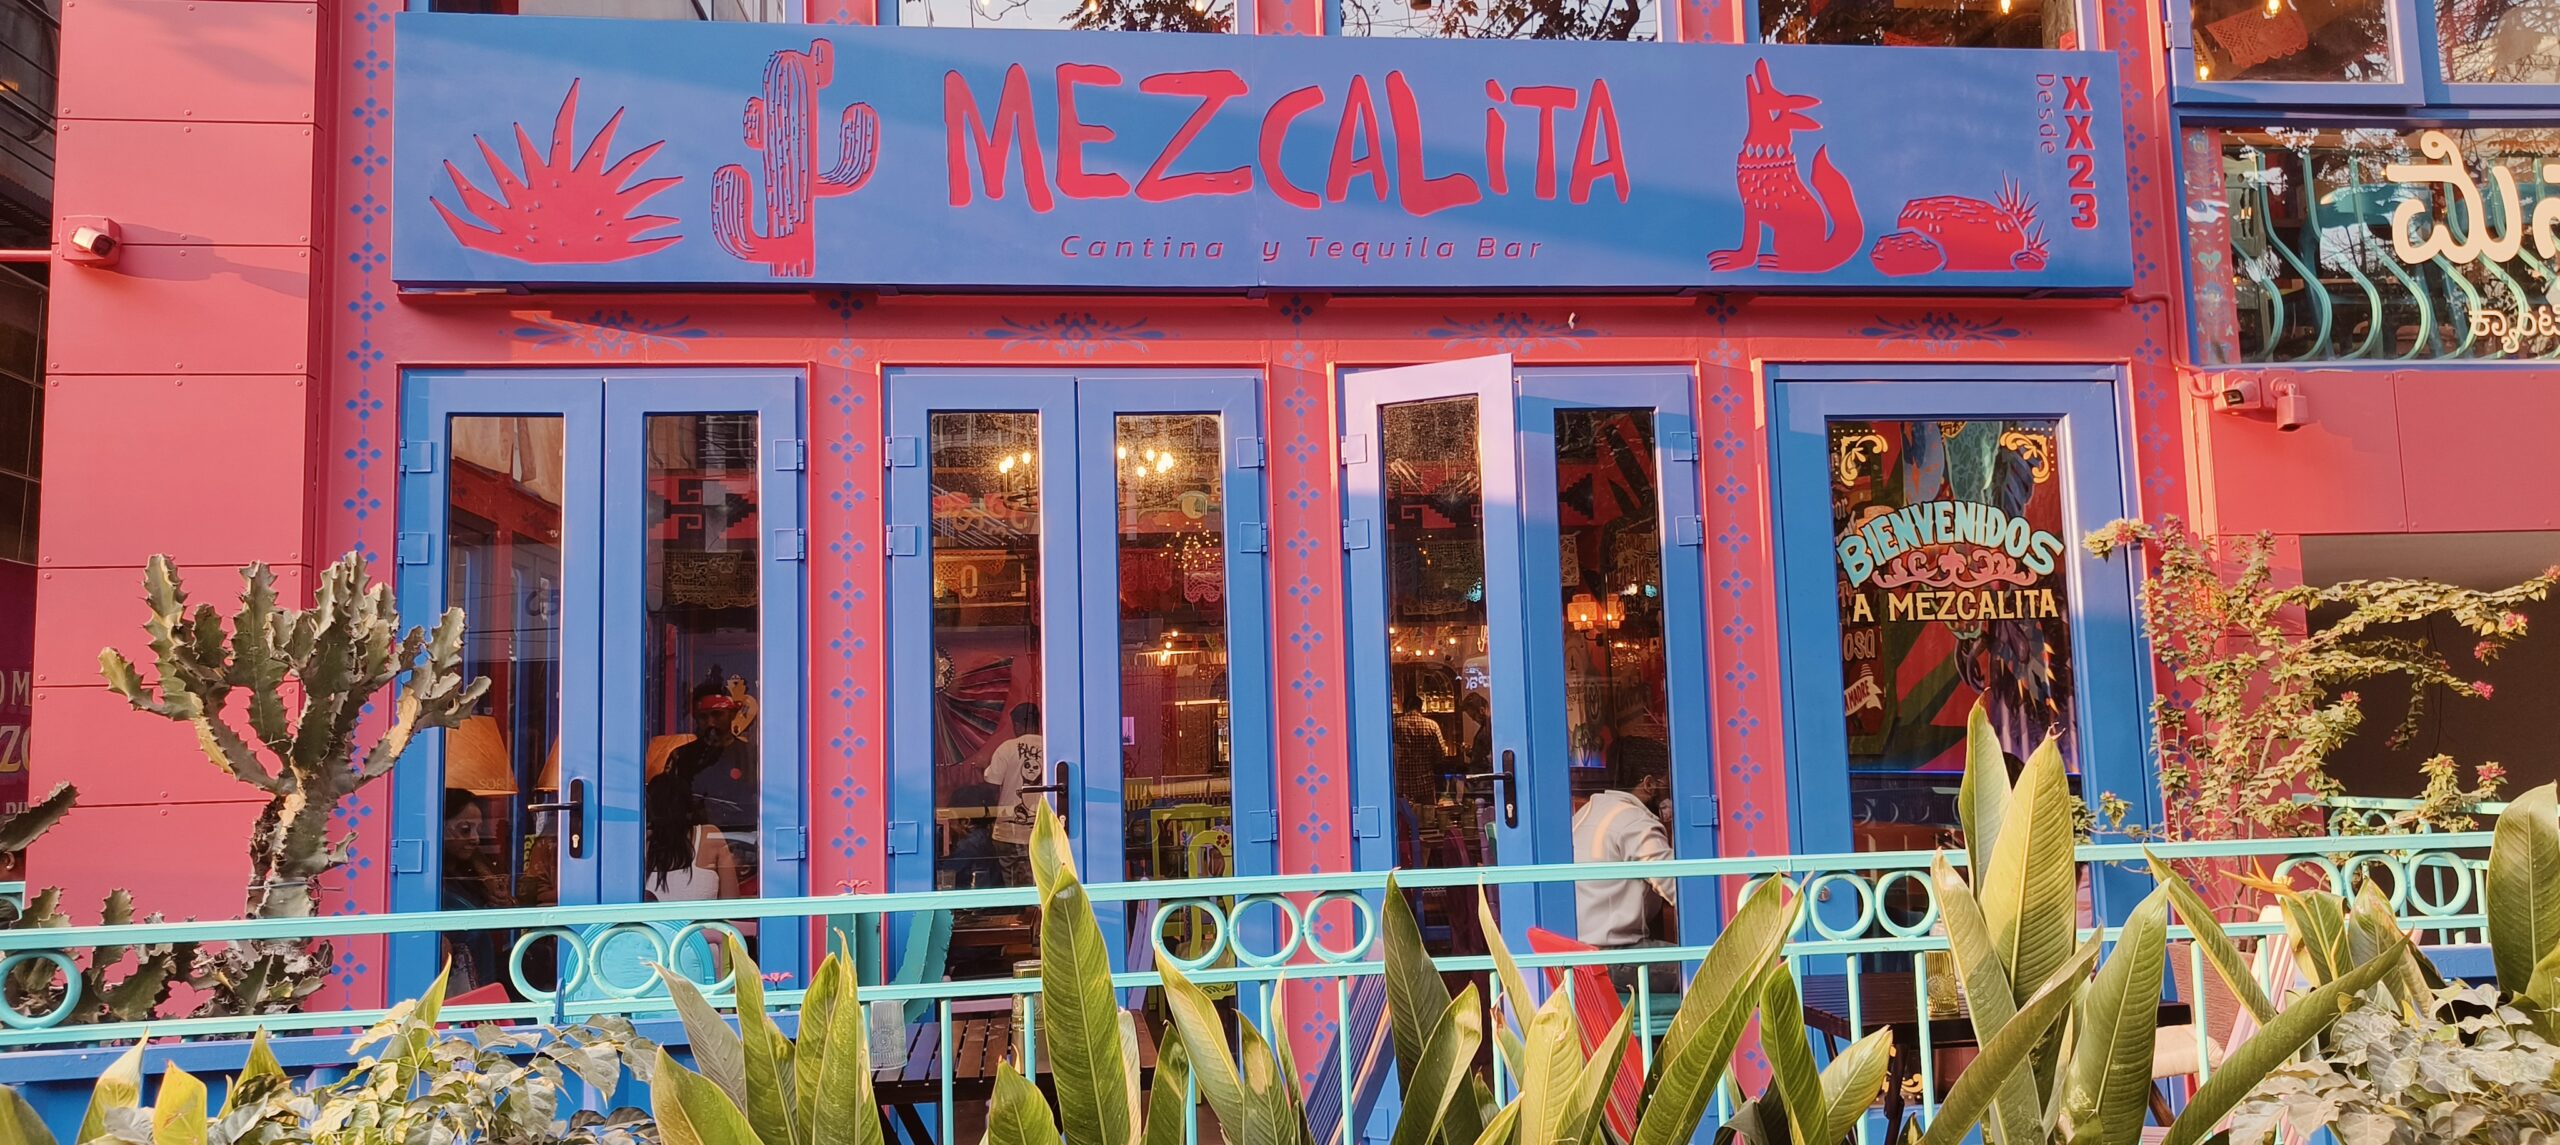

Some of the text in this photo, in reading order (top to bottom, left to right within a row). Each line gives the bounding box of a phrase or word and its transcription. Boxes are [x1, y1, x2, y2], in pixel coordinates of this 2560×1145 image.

[2035, 73, 2060, 155] Desde
[2061, 75, 2098, 231] XX23
[1060, 234, 1544, 264] Cantina y Tequila Bar
[1836, 500, 2066, 589] BIENVENIDOS
[1852, 593, 1875, 623] A
[1888, 588, 2059, 622] MEZCALITA
